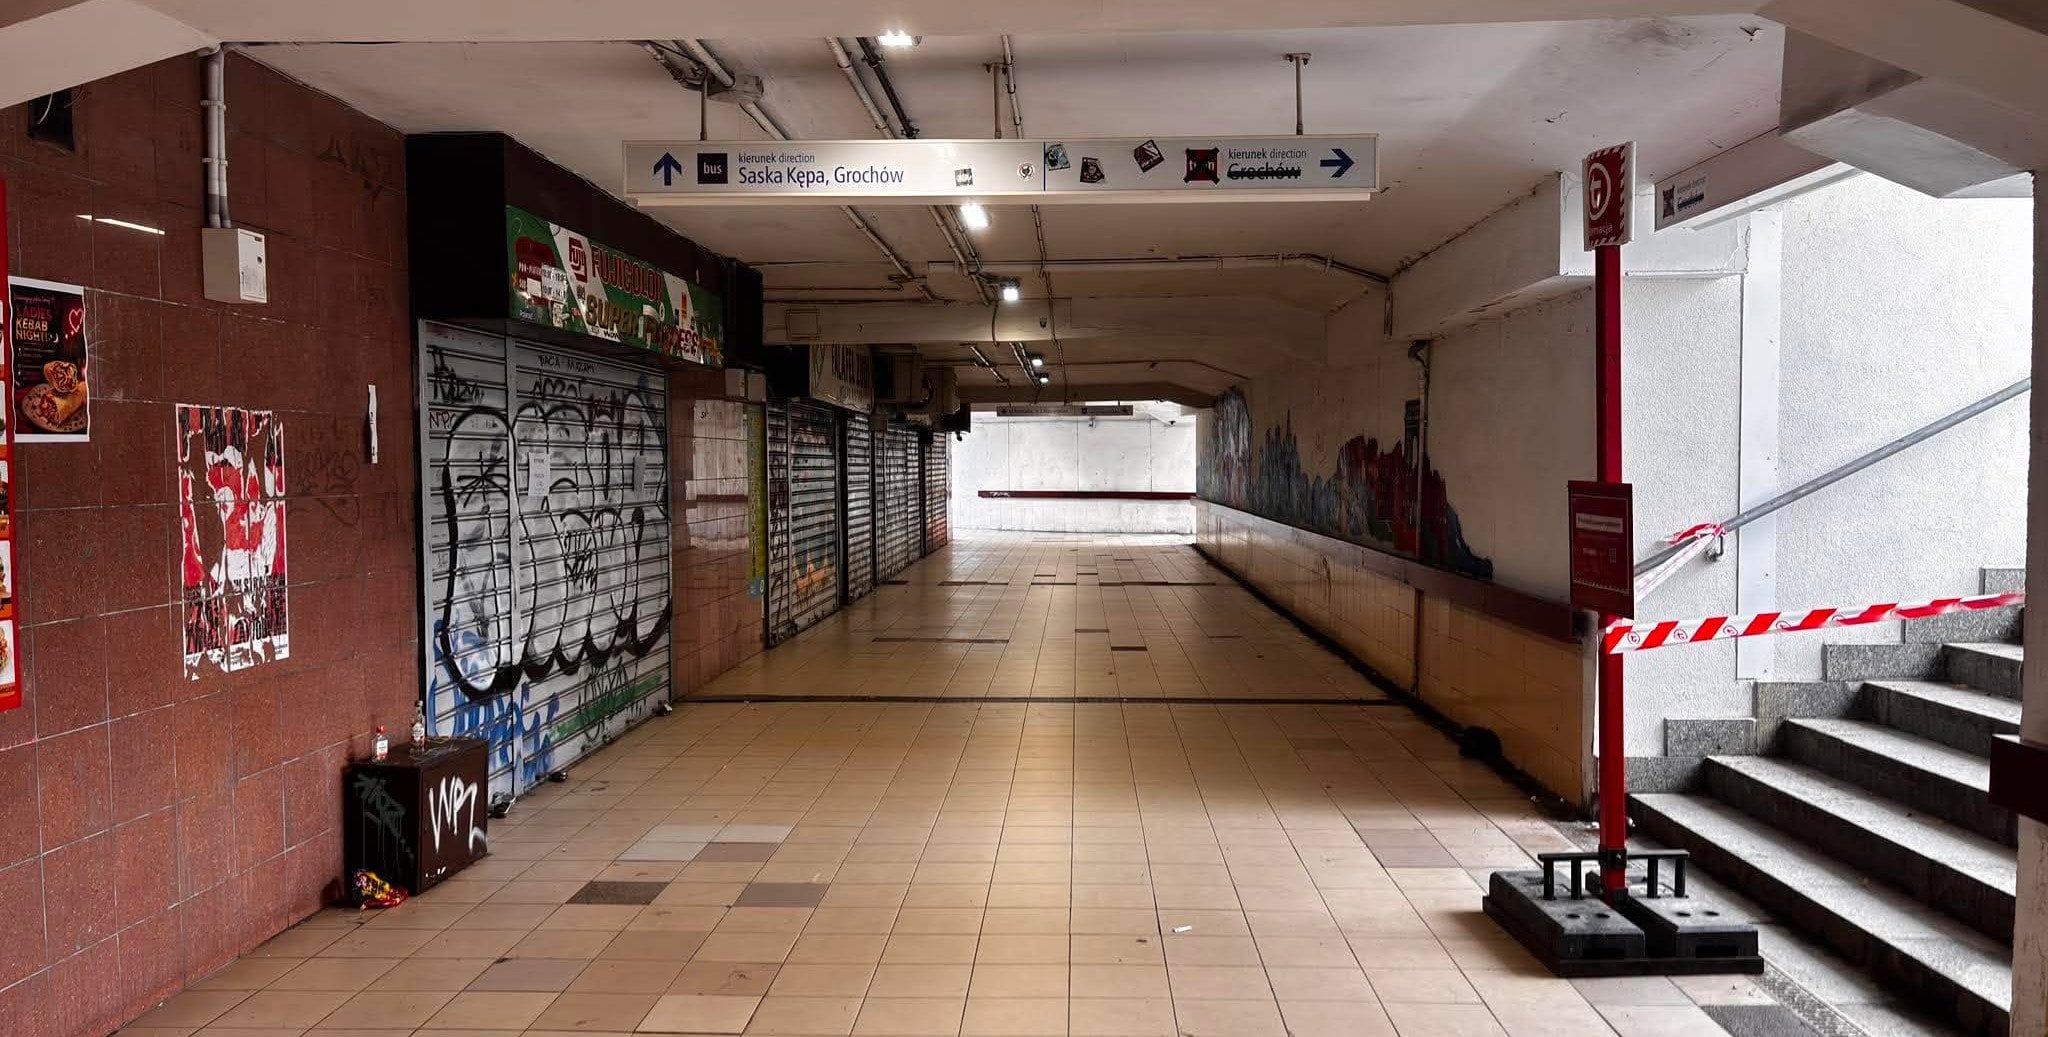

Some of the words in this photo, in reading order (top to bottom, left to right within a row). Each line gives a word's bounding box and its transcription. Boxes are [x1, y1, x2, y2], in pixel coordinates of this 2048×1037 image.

[738, 152, 777, 164] kierunek
[778, 153, 815, 164] direction
[1228, 148, 1267, 160] kierunek
[1269, 148, 1307, 160] direction
[703, 162, 722, 175] bus
[738, 166, 783, 184] Saska
[787, 166, 830, 188] Kępa,
[834, 163, 904, 184] Grochów
[16, 317, 48, 331] KEBAB
